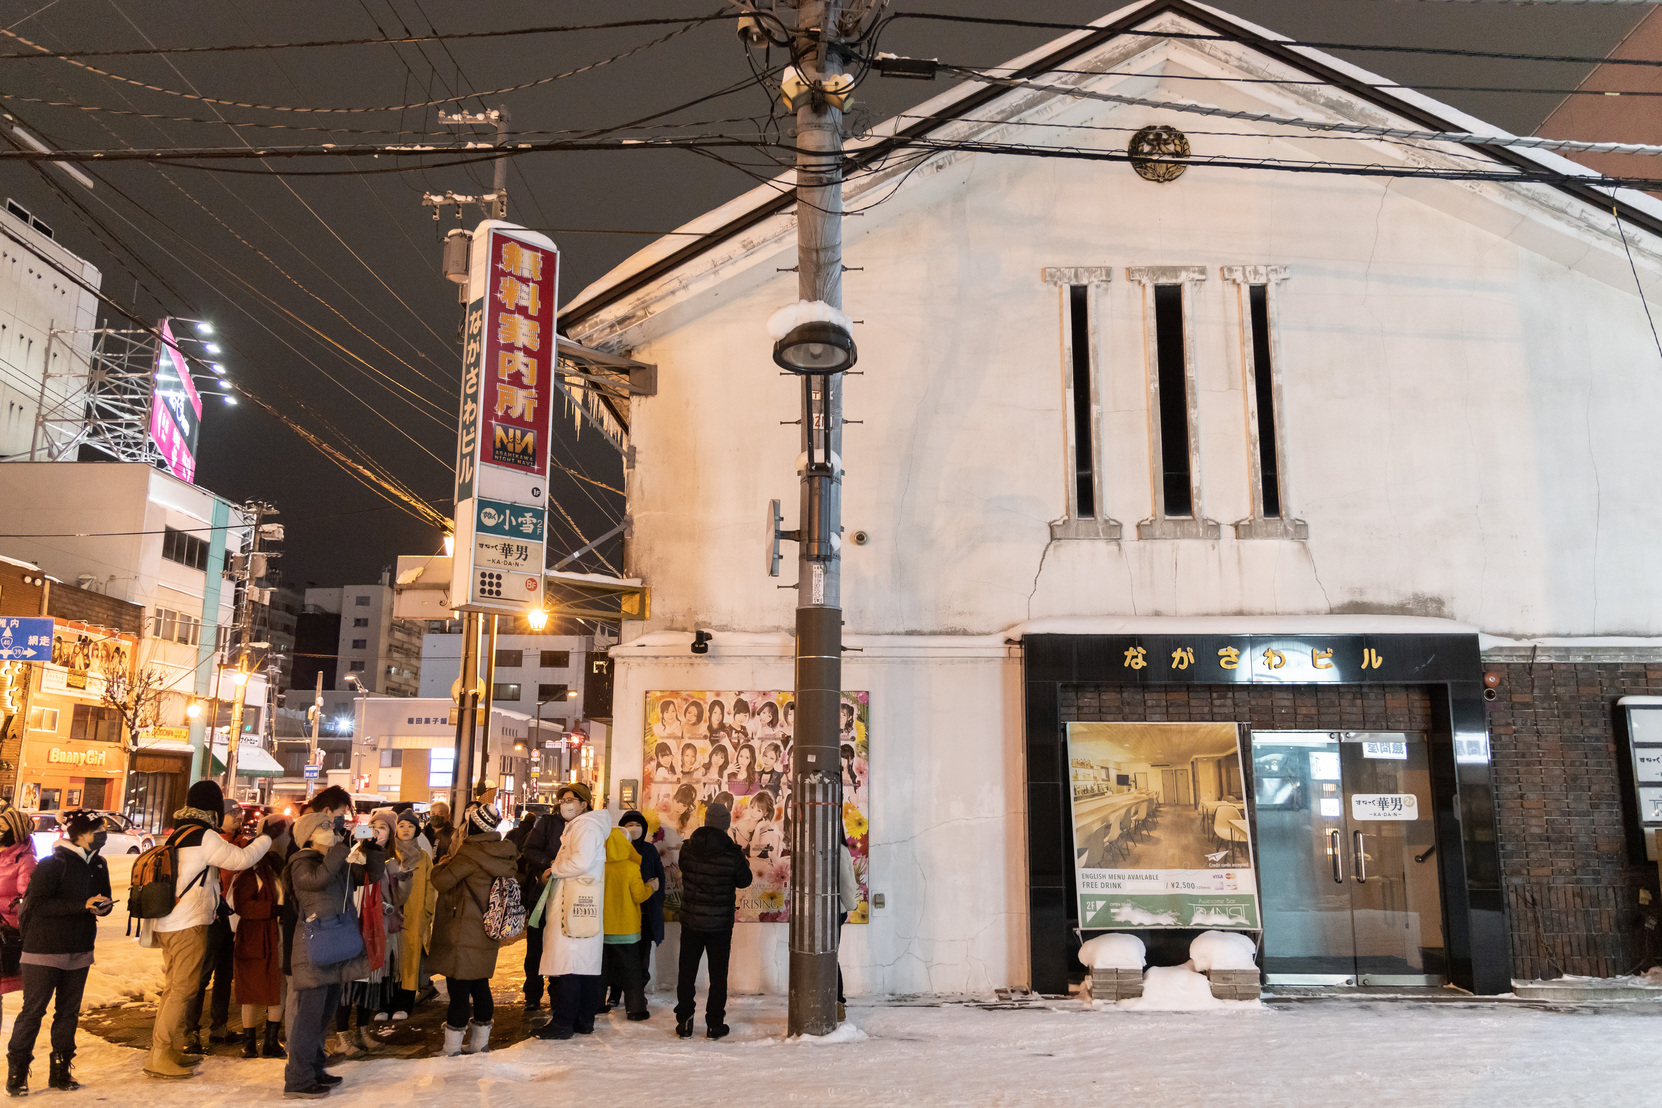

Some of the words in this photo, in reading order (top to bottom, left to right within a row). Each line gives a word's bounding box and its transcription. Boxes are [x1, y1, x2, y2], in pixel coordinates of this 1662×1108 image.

[495, 241, 542, 422] 無料案内所
[459, 310, 483, 485] ながさわビル
[494, 455, 515, 463] NIGHT
[495, 450, 534, 461] ASAHIKAWA
[497, 509, 537, 534] 小雪
[28, 635, 51, 647] 網走
[1123, 646, 1383, 670] ながさわビル
[48, 747, 106, 767] BunnyGirl
[743, 899, 779, 910] RISING
[1086, 901, 1095, 910] 2F
